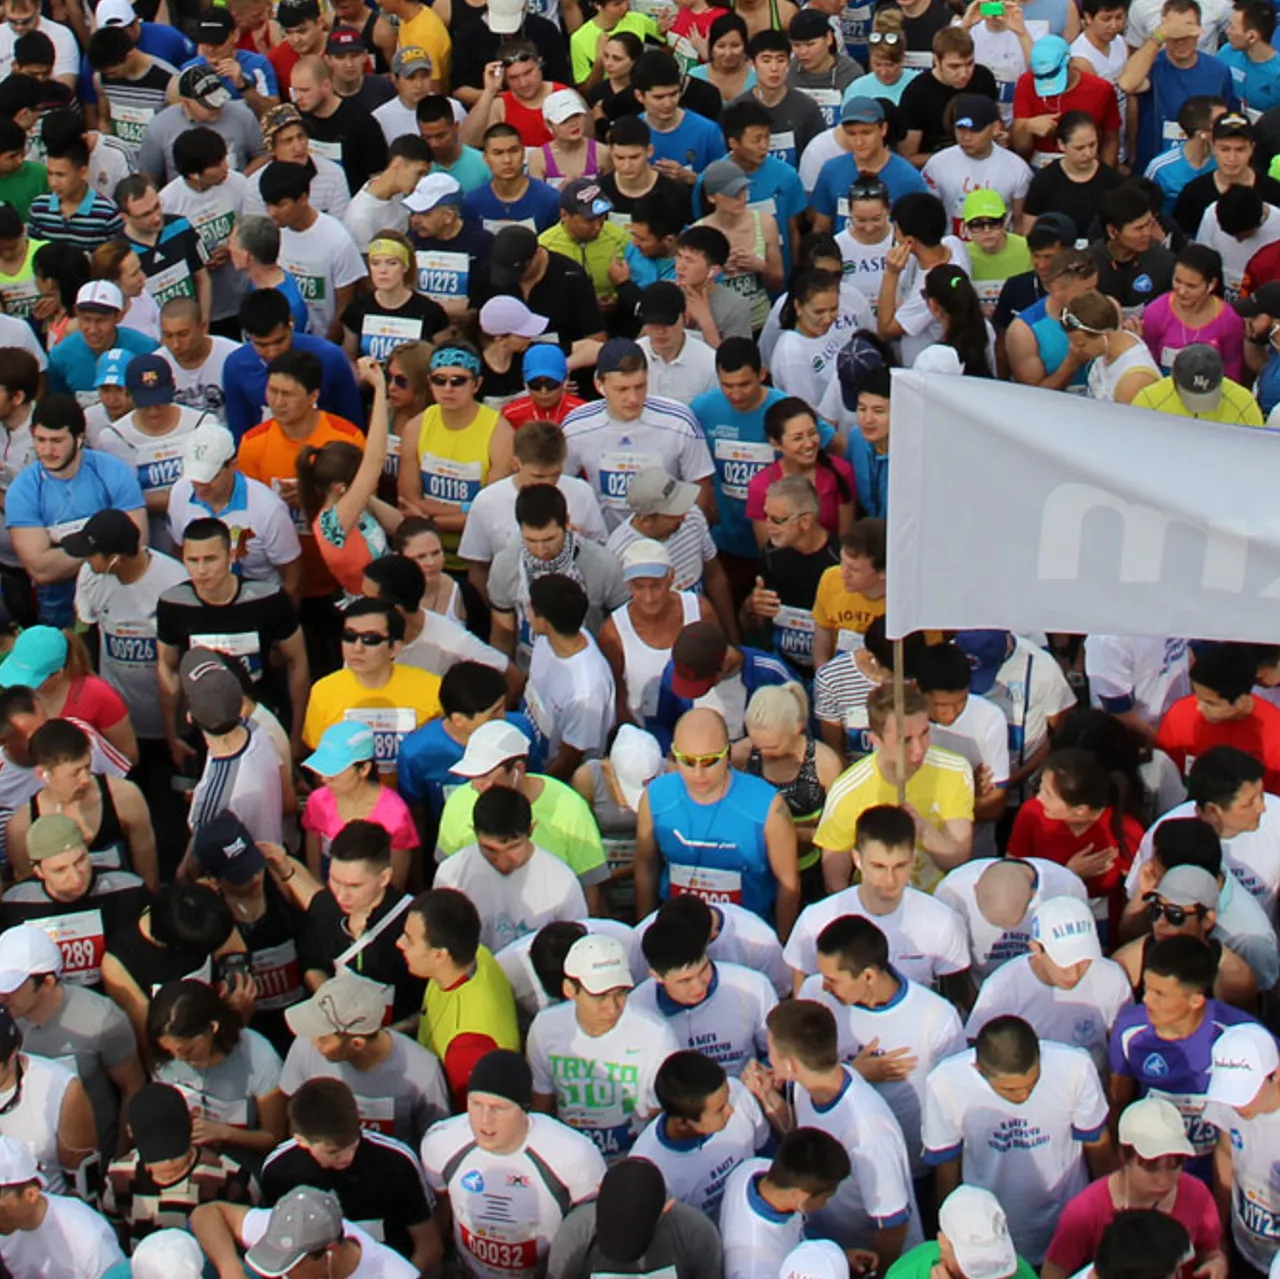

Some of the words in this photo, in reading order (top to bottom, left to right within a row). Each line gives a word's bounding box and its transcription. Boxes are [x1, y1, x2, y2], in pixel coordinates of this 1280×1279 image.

[419, 269, 458, 292] 01273
[430, 476, 468, 499] 01118
[549, 1055, 596, 1078] TRY
[605, 1061, 638, 1083] TO
[558, 1076, 637, 1111] STOP
[468, 1232, 524, 1268] 00032
